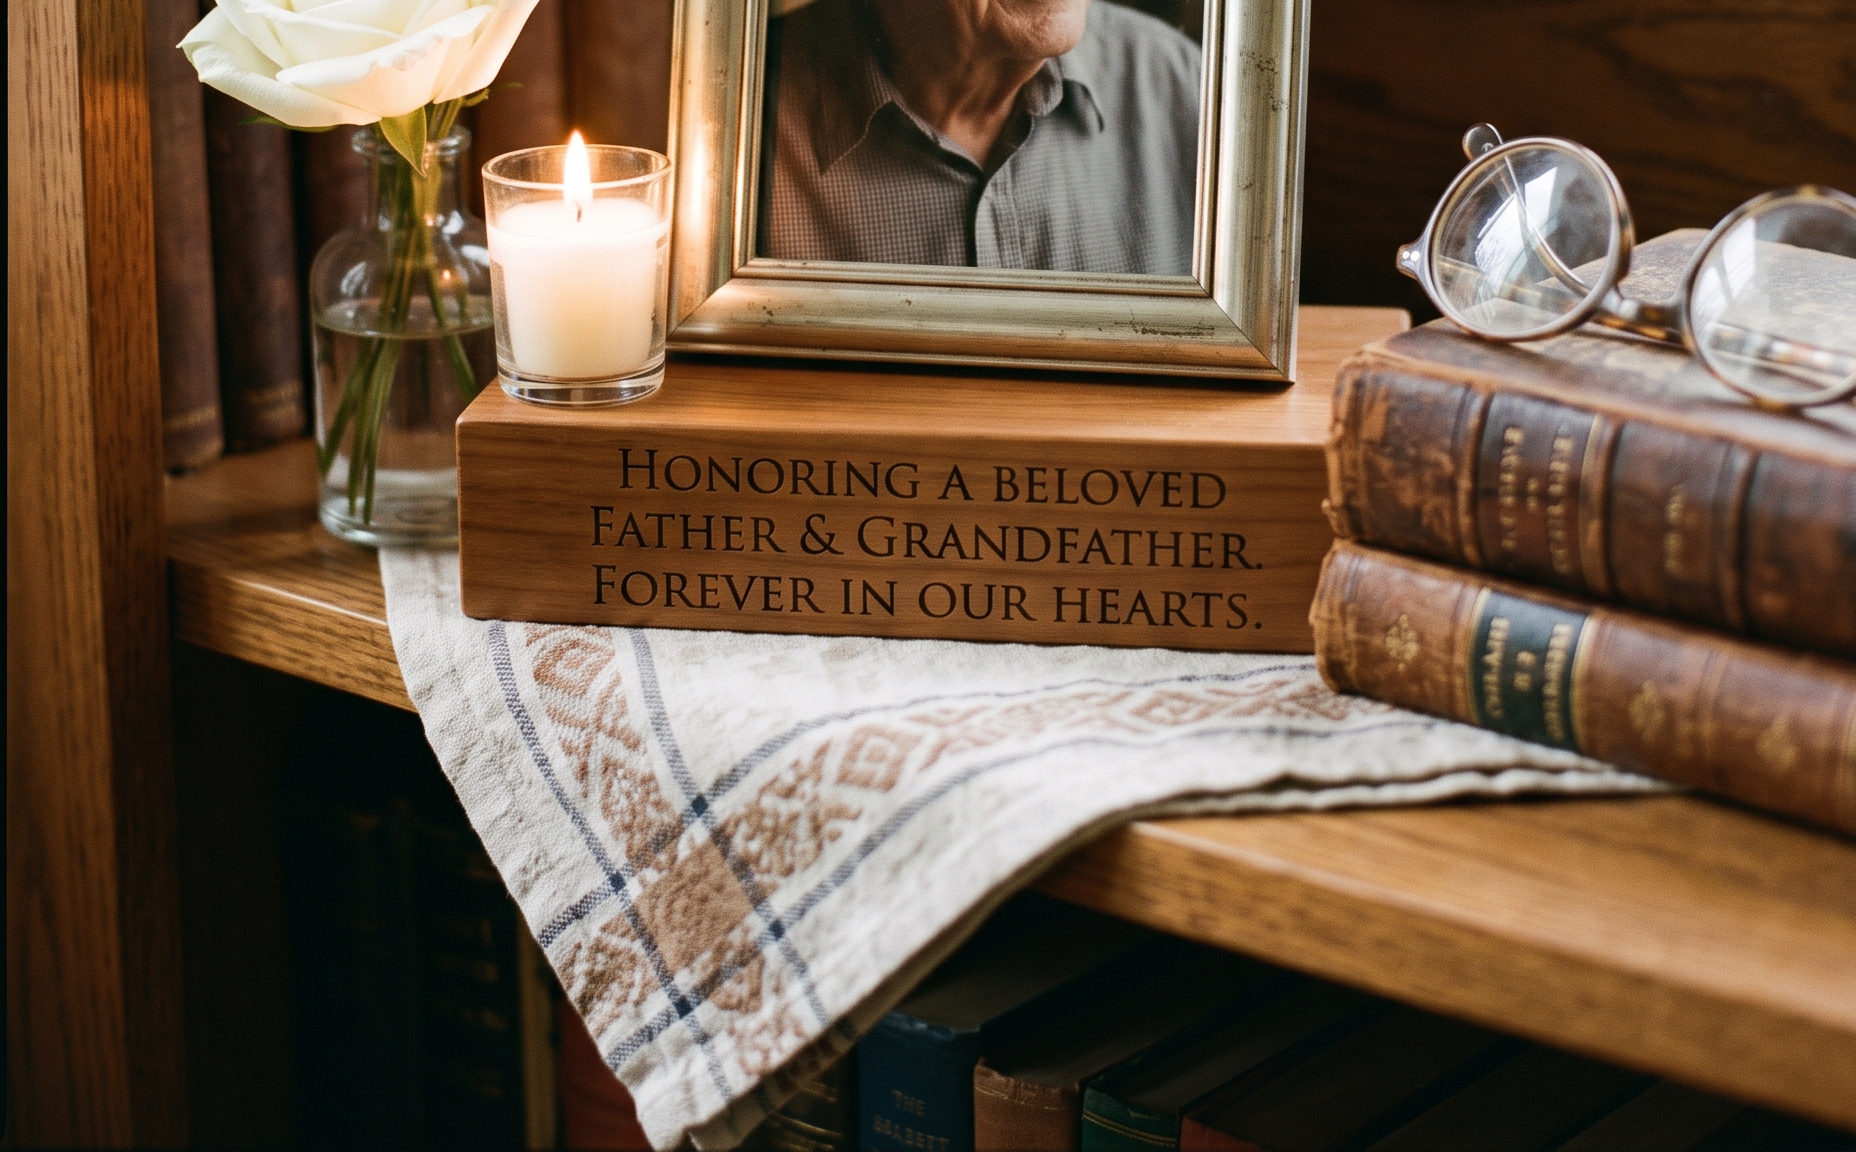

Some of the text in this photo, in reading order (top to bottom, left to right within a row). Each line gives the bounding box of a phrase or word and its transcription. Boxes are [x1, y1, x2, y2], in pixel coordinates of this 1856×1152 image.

[618, 448, 1226, 508] HONORING A BELOVED
[590, 506, 1263, 569] FATHER & GRANDFATHER.
[592, 565, 1262, 629] FOREVER IN OUR HEARTS.
